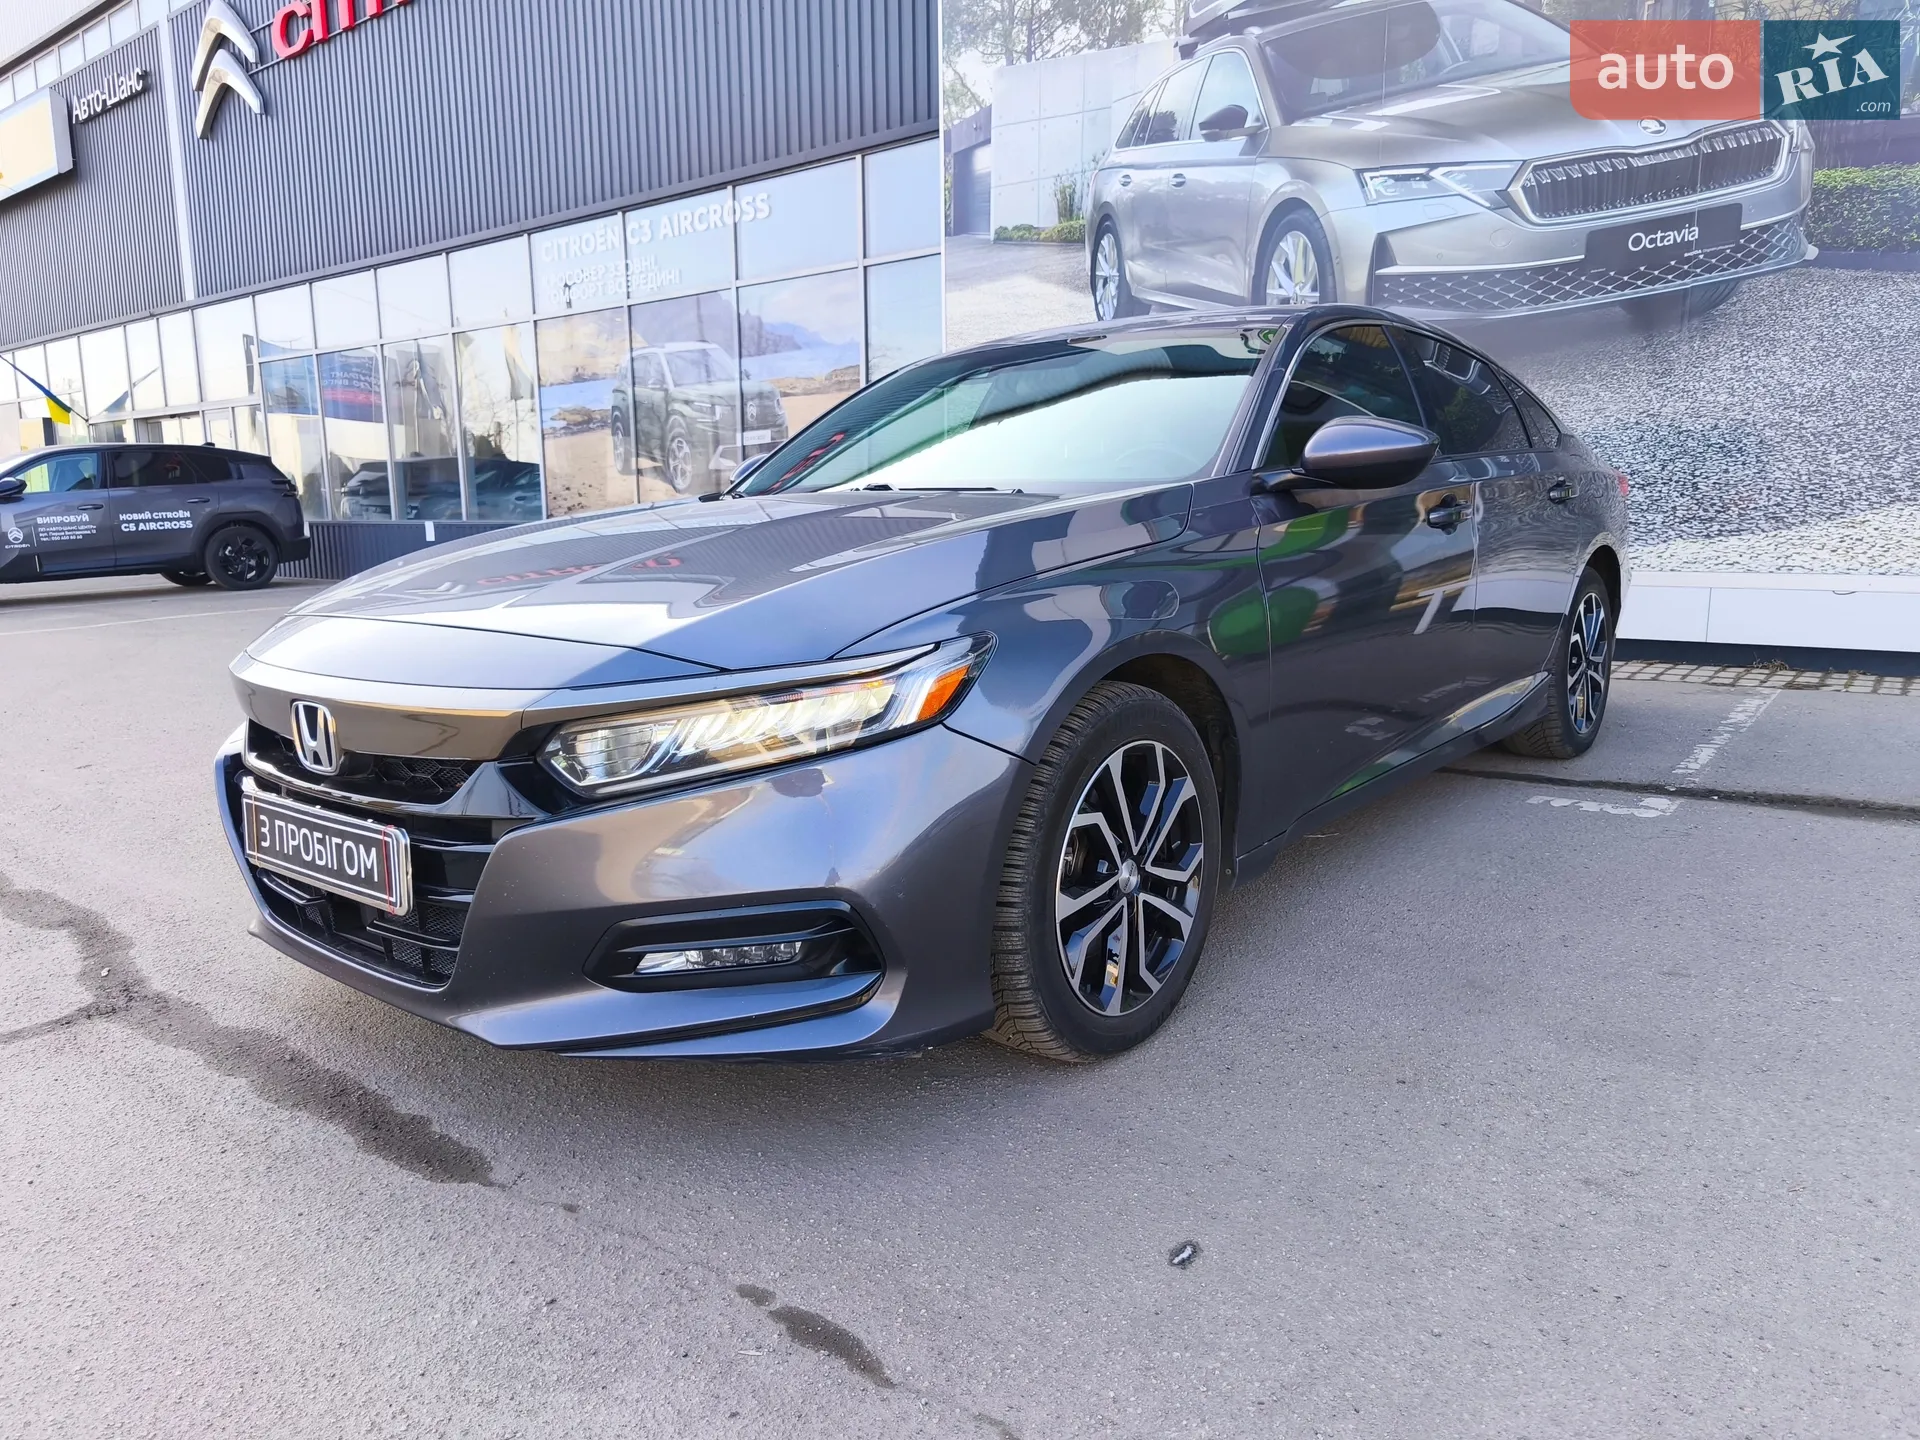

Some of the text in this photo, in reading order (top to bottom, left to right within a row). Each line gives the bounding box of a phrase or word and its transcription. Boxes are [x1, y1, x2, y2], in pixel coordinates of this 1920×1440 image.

[541, 192, 771, 263] CITROËN C3 AIRCROSS
[1628, 224, 1699, 252] Octavia
[36, 513, 90, 525] ВИПРОБУЙ
[119, 510, 191, 521] НОВИЙ CITROËN
[121, 520, 193, 532] C5 AIRCROSS
[259, 814, 379, 882] З ПРОБІГОМ
